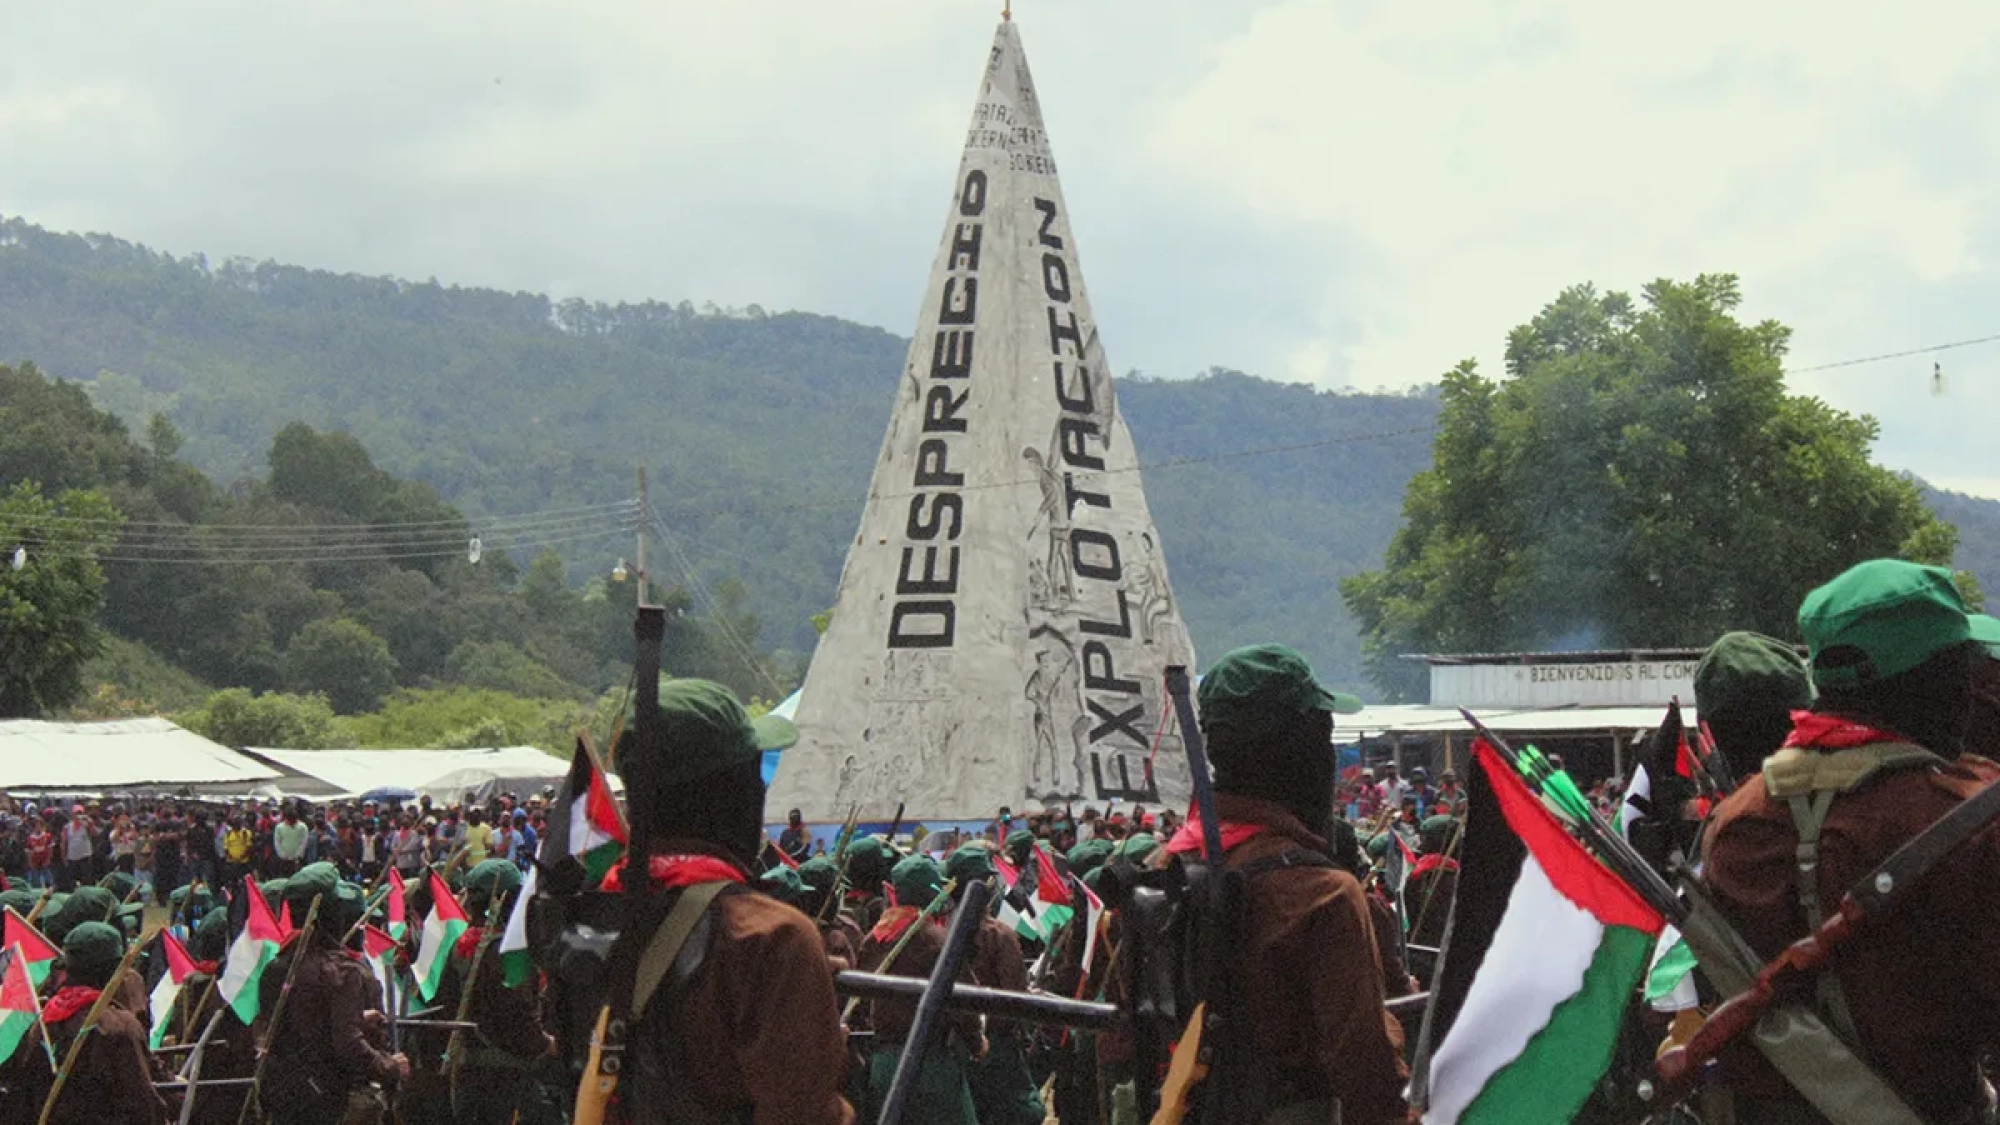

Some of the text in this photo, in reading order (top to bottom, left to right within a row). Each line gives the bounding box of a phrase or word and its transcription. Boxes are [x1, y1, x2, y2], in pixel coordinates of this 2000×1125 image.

[887, 169, 987, 649] DESPRECIO
[1034, 197, 1161, 804] EXPLOTACION
[1638, 664, 1658, 680] AL
